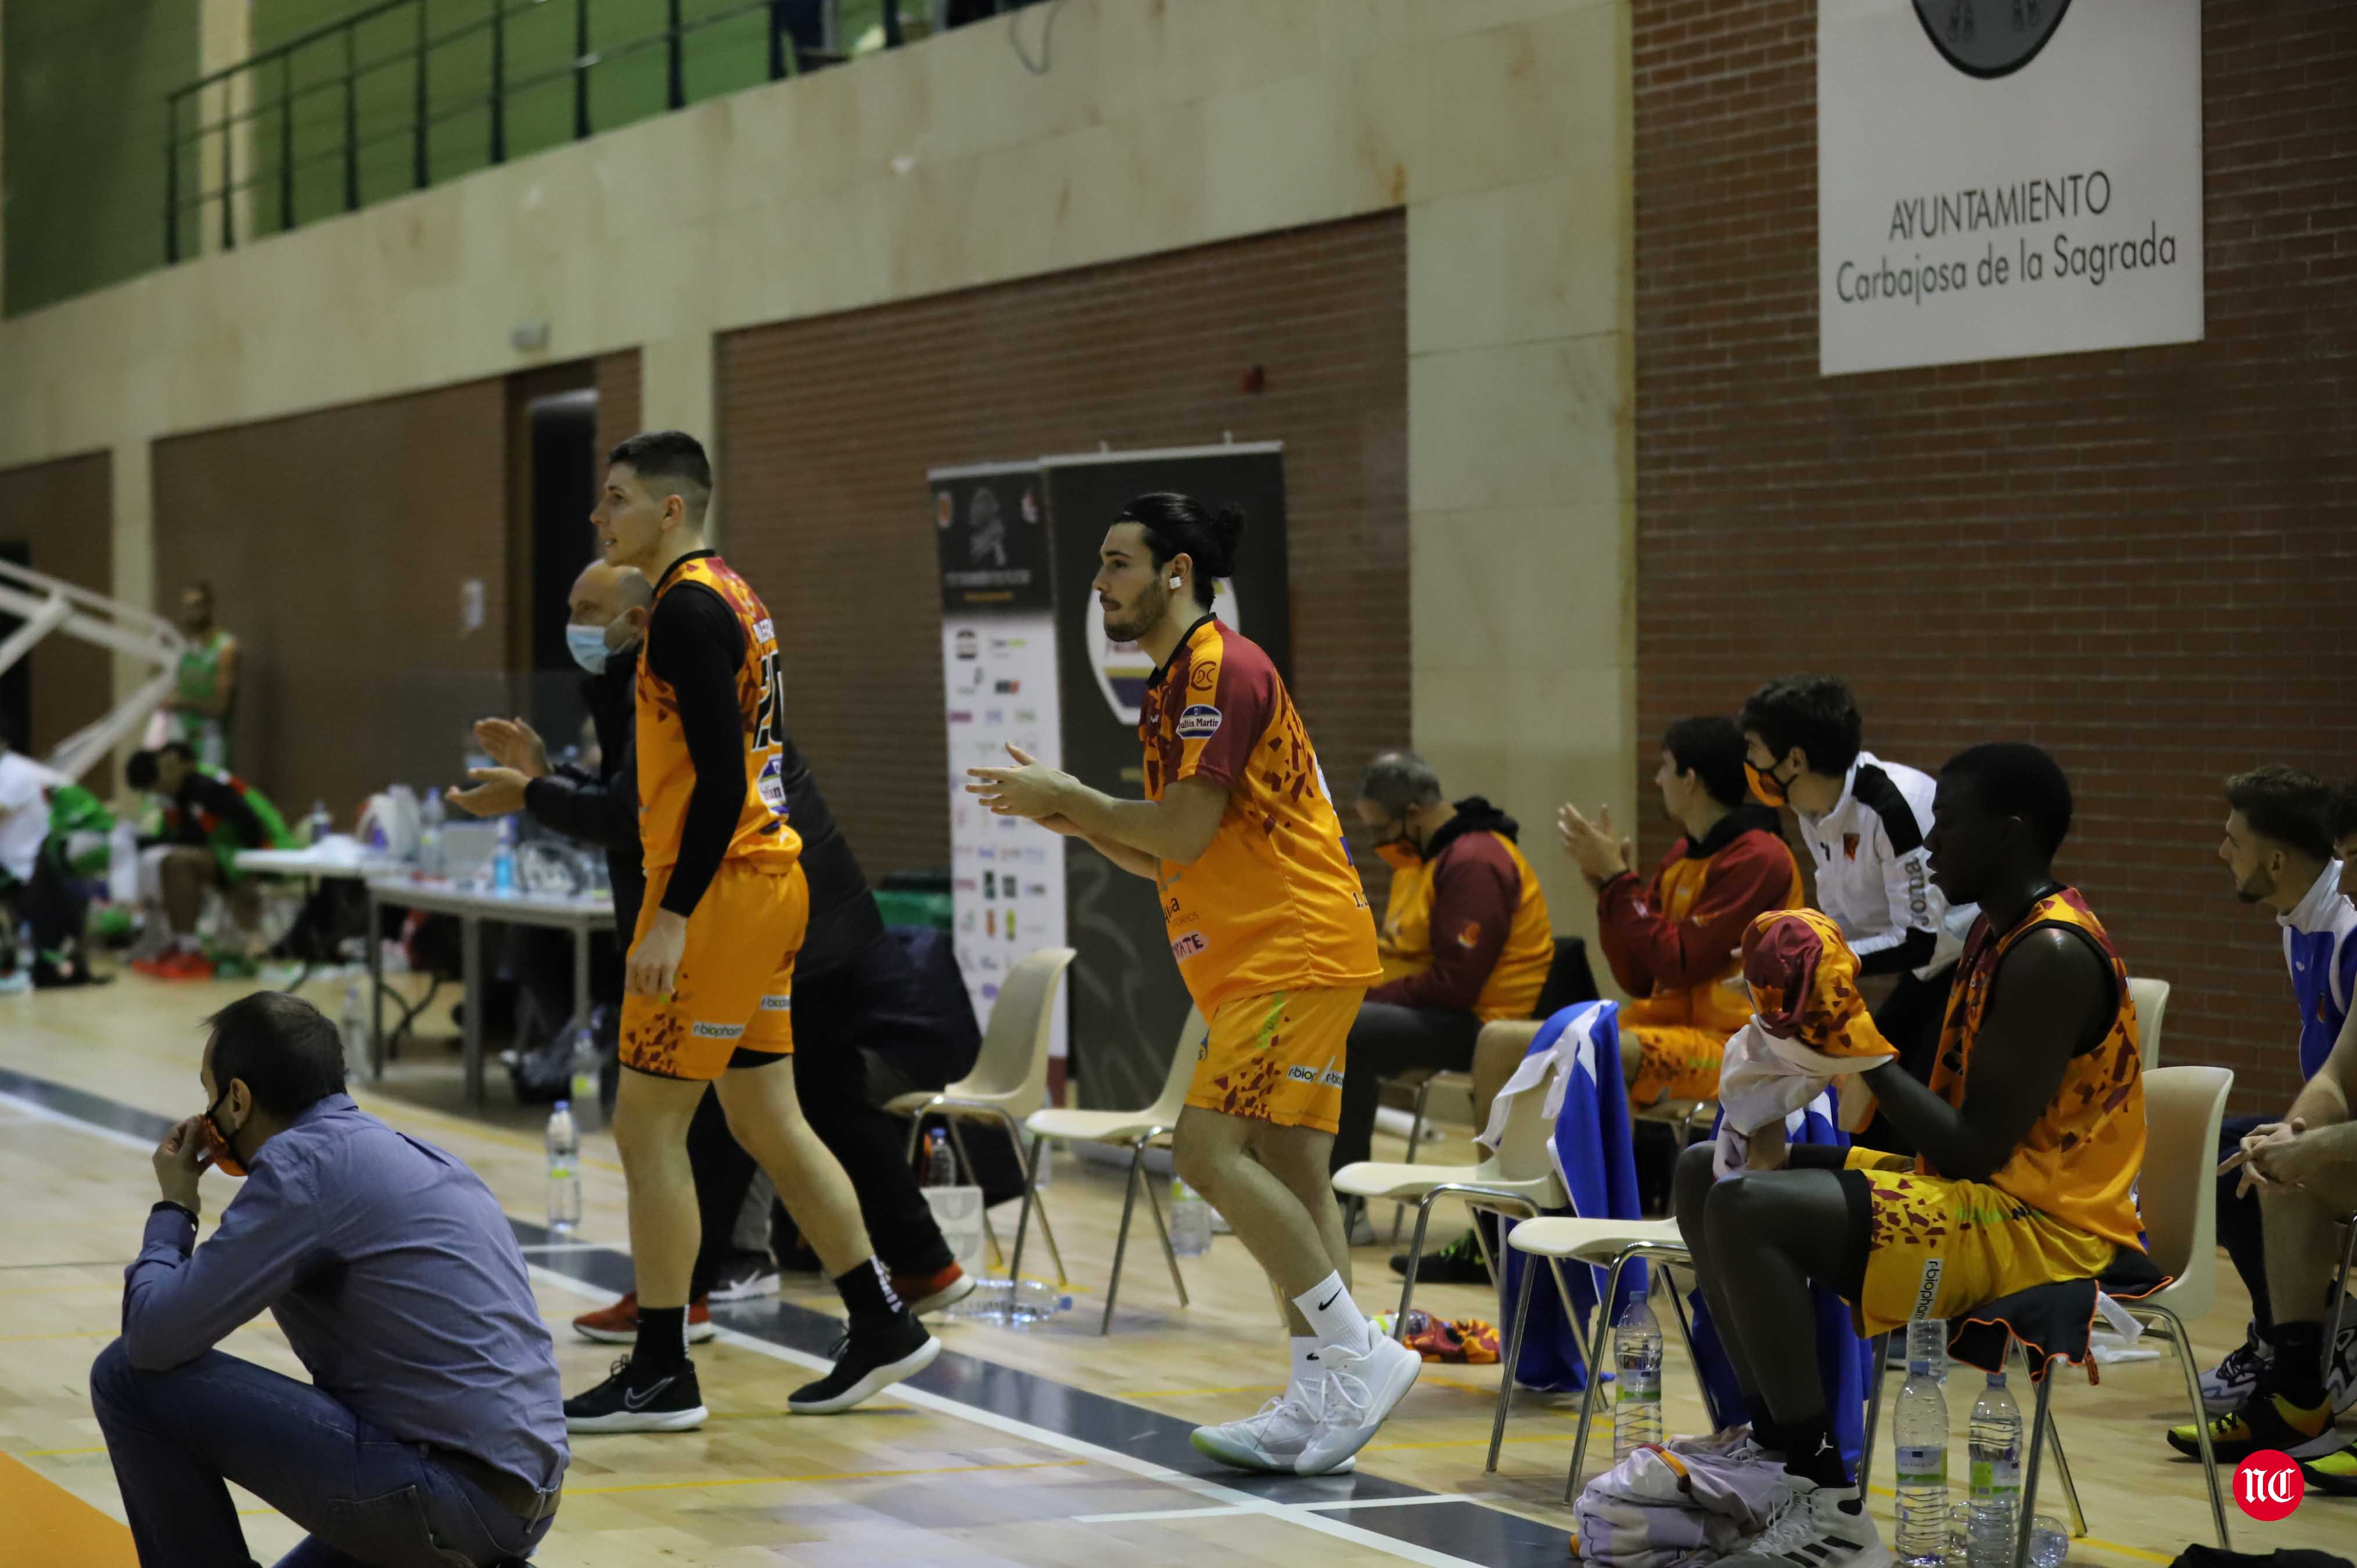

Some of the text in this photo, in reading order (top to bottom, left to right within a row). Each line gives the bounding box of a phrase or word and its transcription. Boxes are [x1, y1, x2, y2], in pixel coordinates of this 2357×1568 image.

[1889, 171, 2111, 240] AYUNTAMIENTO
[1836, 221, 2176, 305] Carbajosa de la Sagrada
